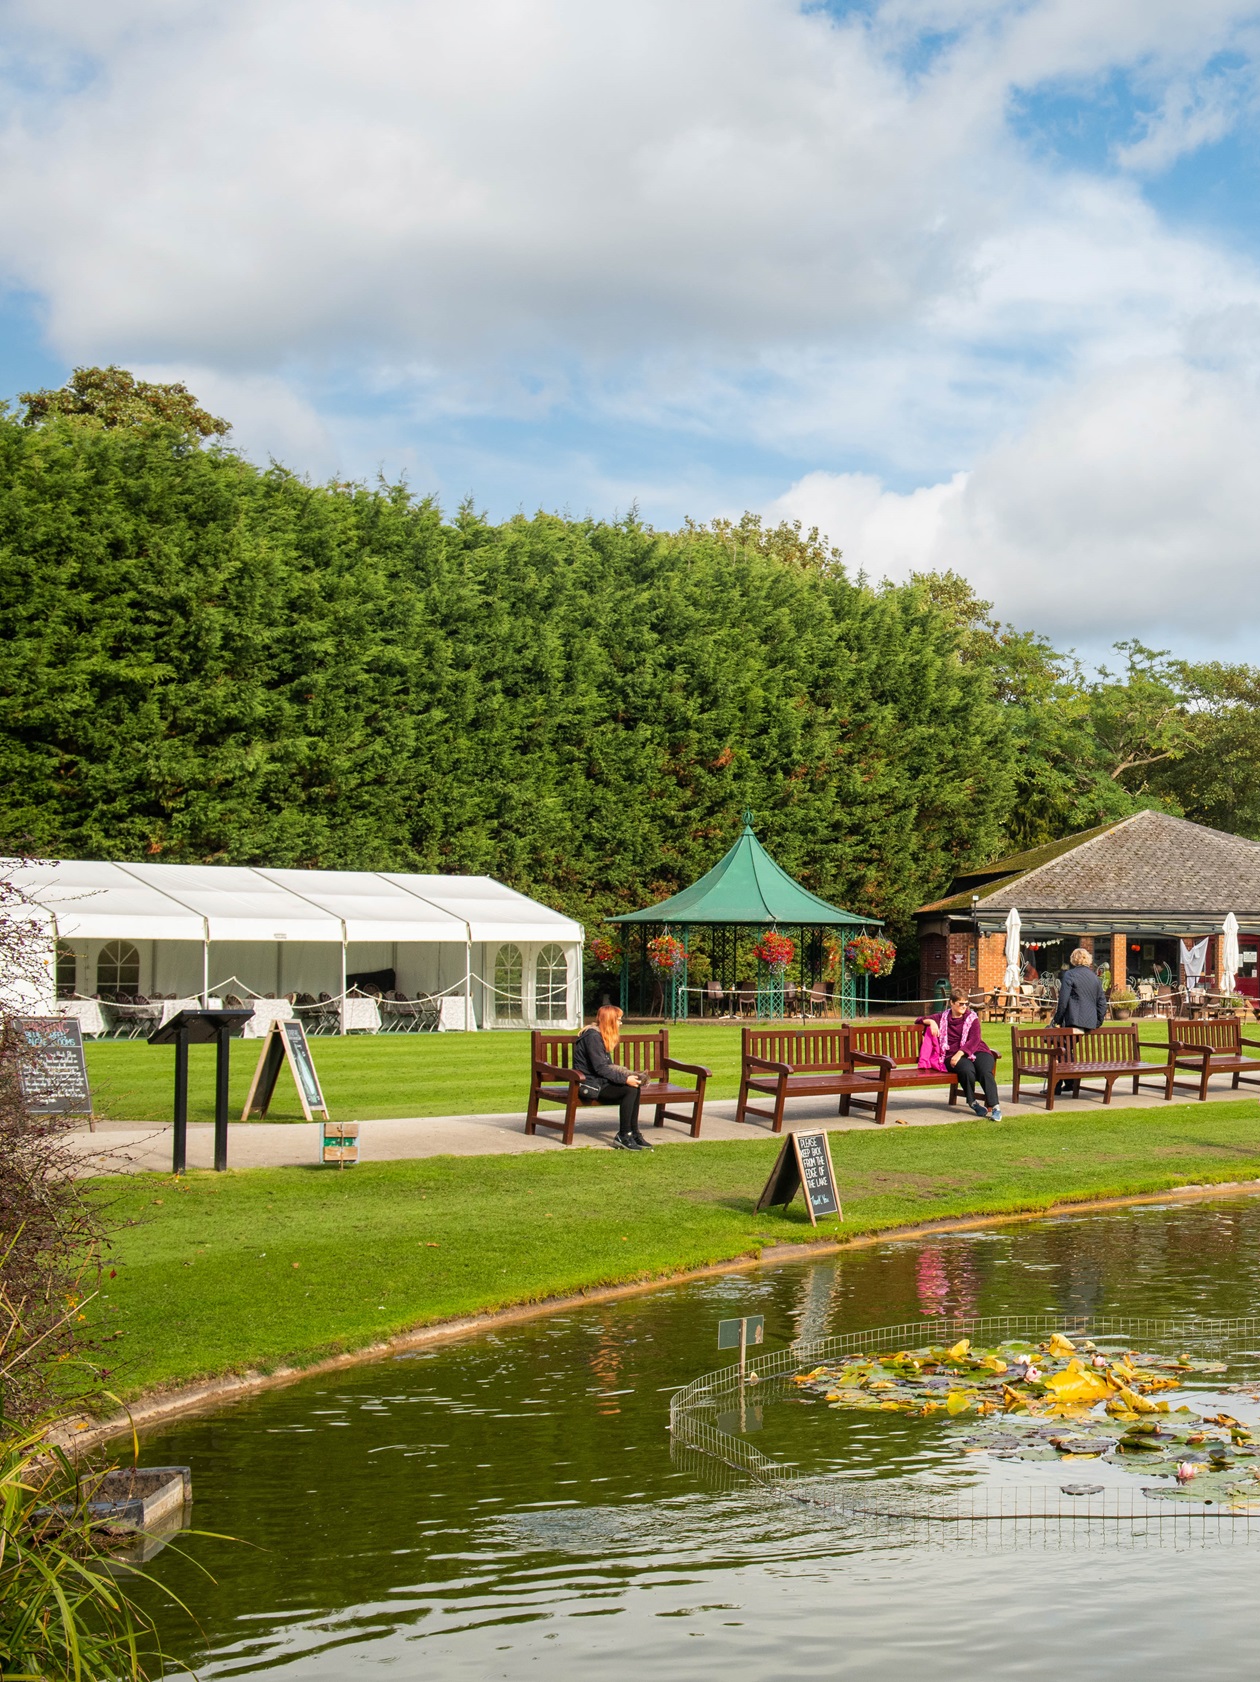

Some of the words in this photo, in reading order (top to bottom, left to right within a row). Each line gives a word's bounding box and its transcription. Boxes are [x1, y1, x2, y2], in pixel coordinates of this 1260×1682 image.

[800, 1137, 818, 1149] PLEASE
[811, 1146, 822, 1157] BACK
[803, 1157, 816, 1169] FROM
[815, 1155, 825, 1166] THE
[805, 1167, 818, 1179] EDGE
[818, 1165, 825, 1176] OF
[807, 1178, 816, 1189] THE
[815, 1176, 828, 1188] LAKE
